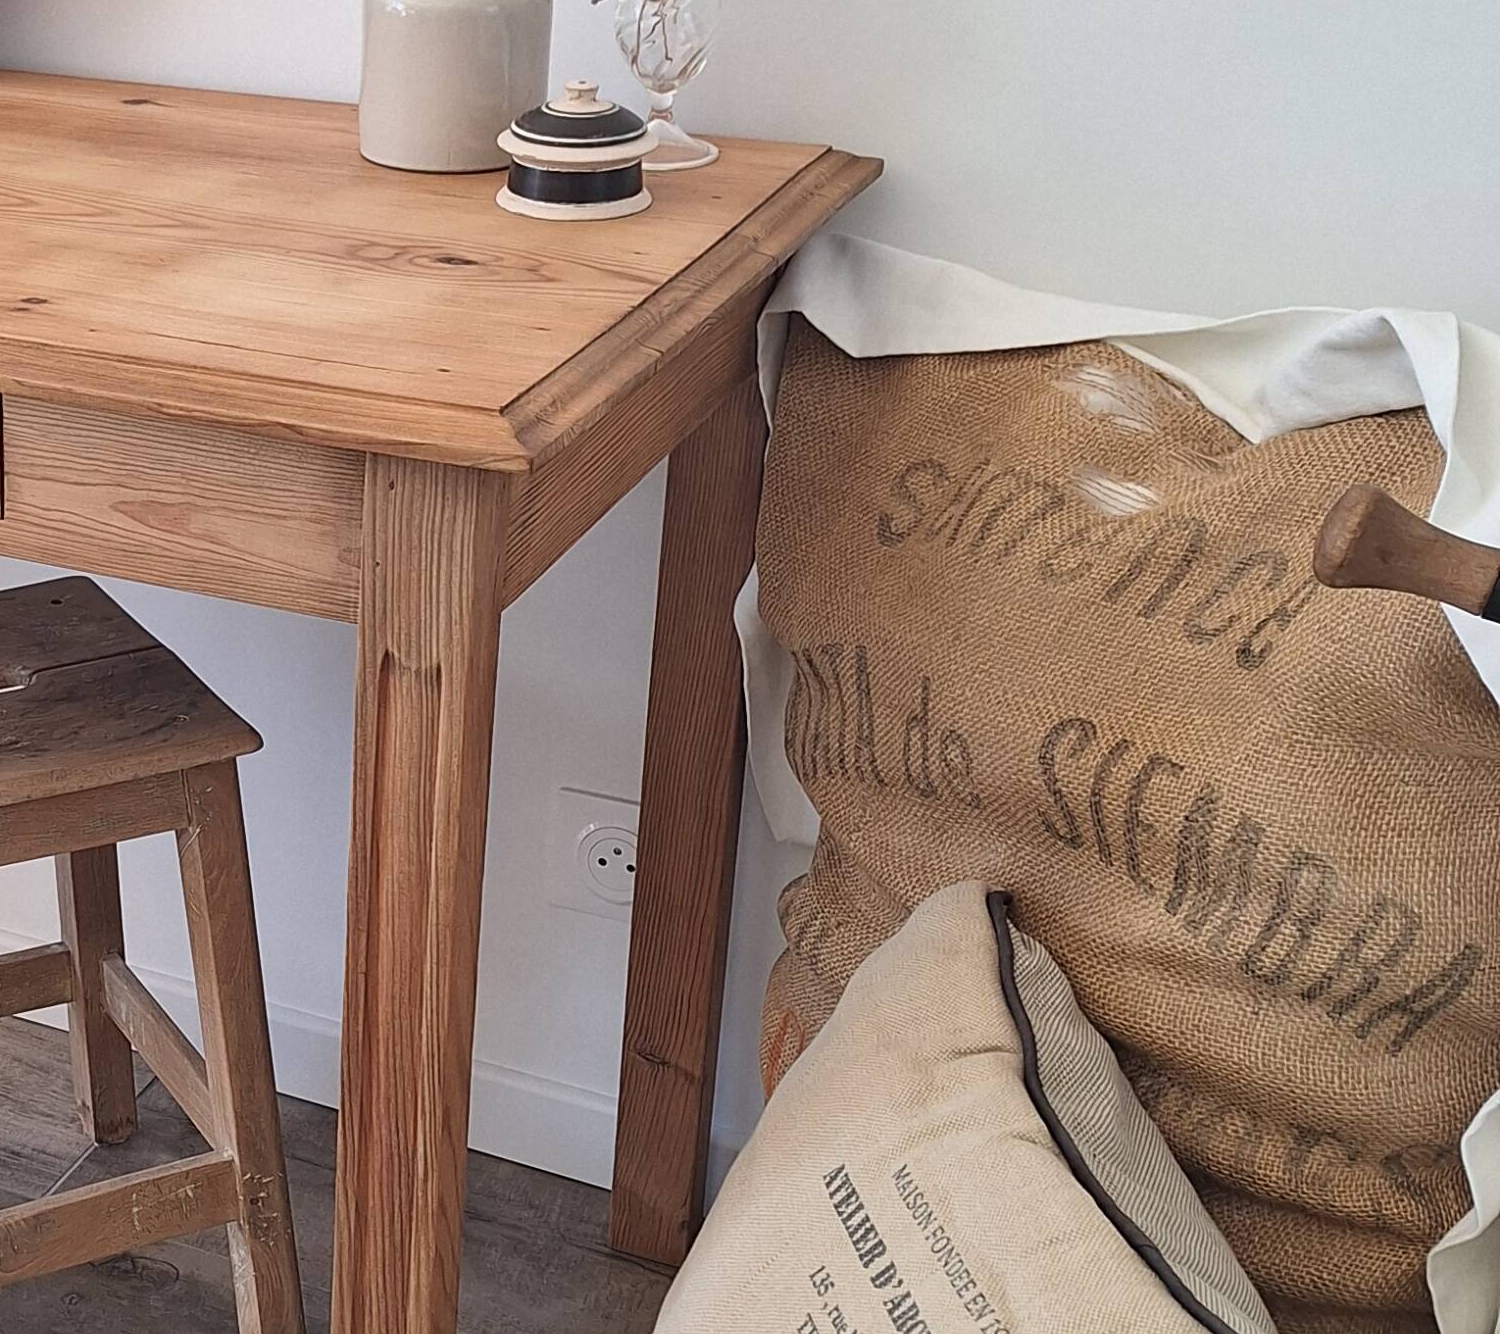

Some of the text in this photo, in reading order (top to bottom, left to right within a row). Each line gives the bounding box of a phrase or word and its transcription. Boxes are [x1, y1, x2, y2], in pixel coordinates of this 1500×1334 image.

[823, 1163, 887, 1268] ATELIER
[891, 1164, 937, 1232] MAISON
[925, 1225, 977, 1300] FONDEE
[963, 1292, 995, 1323] EN
